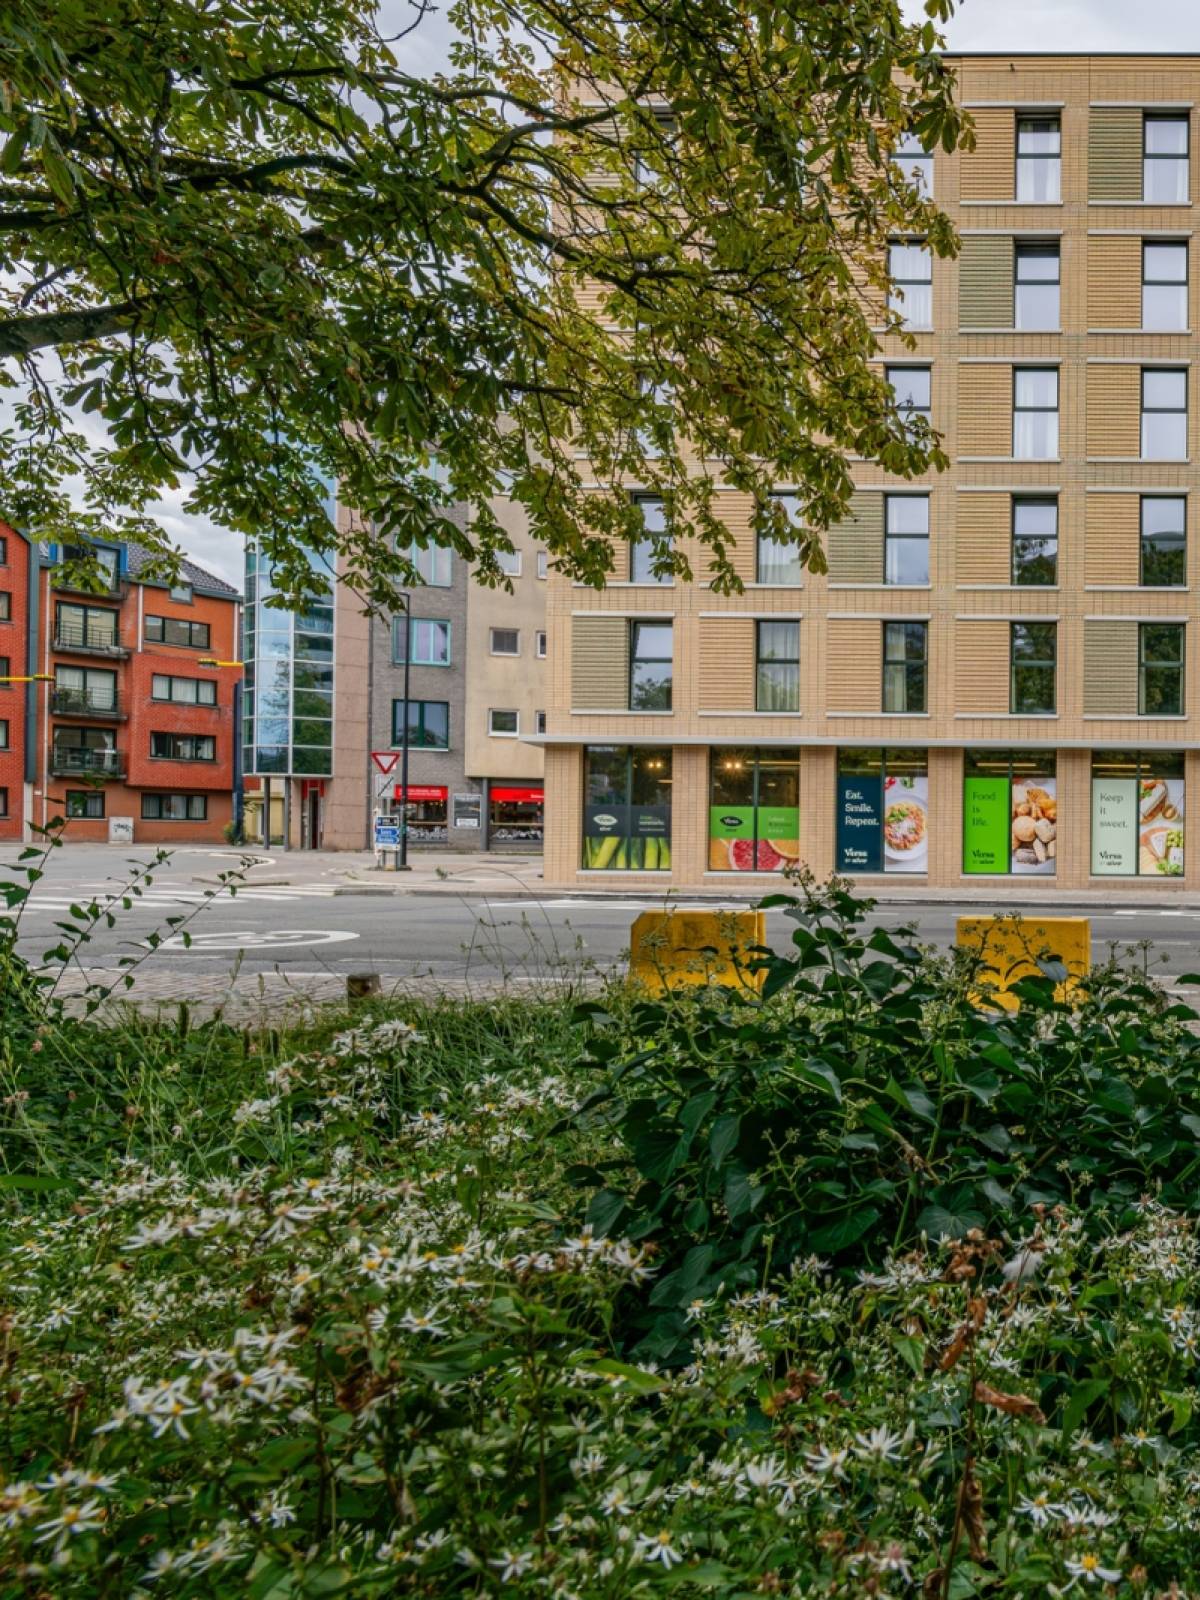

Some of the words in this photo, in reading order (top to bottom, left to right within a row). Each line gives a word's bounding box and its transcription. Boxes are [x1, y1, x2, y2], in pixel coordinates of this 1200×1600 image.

[845, 790, 864, 800] Eat.
[973, 792, 996, 801] Food
[1100, 793, 1124, 804] Keep
[845, 803, 874, 813] Smile.
[845, 815, 880, 828] Repeat.
